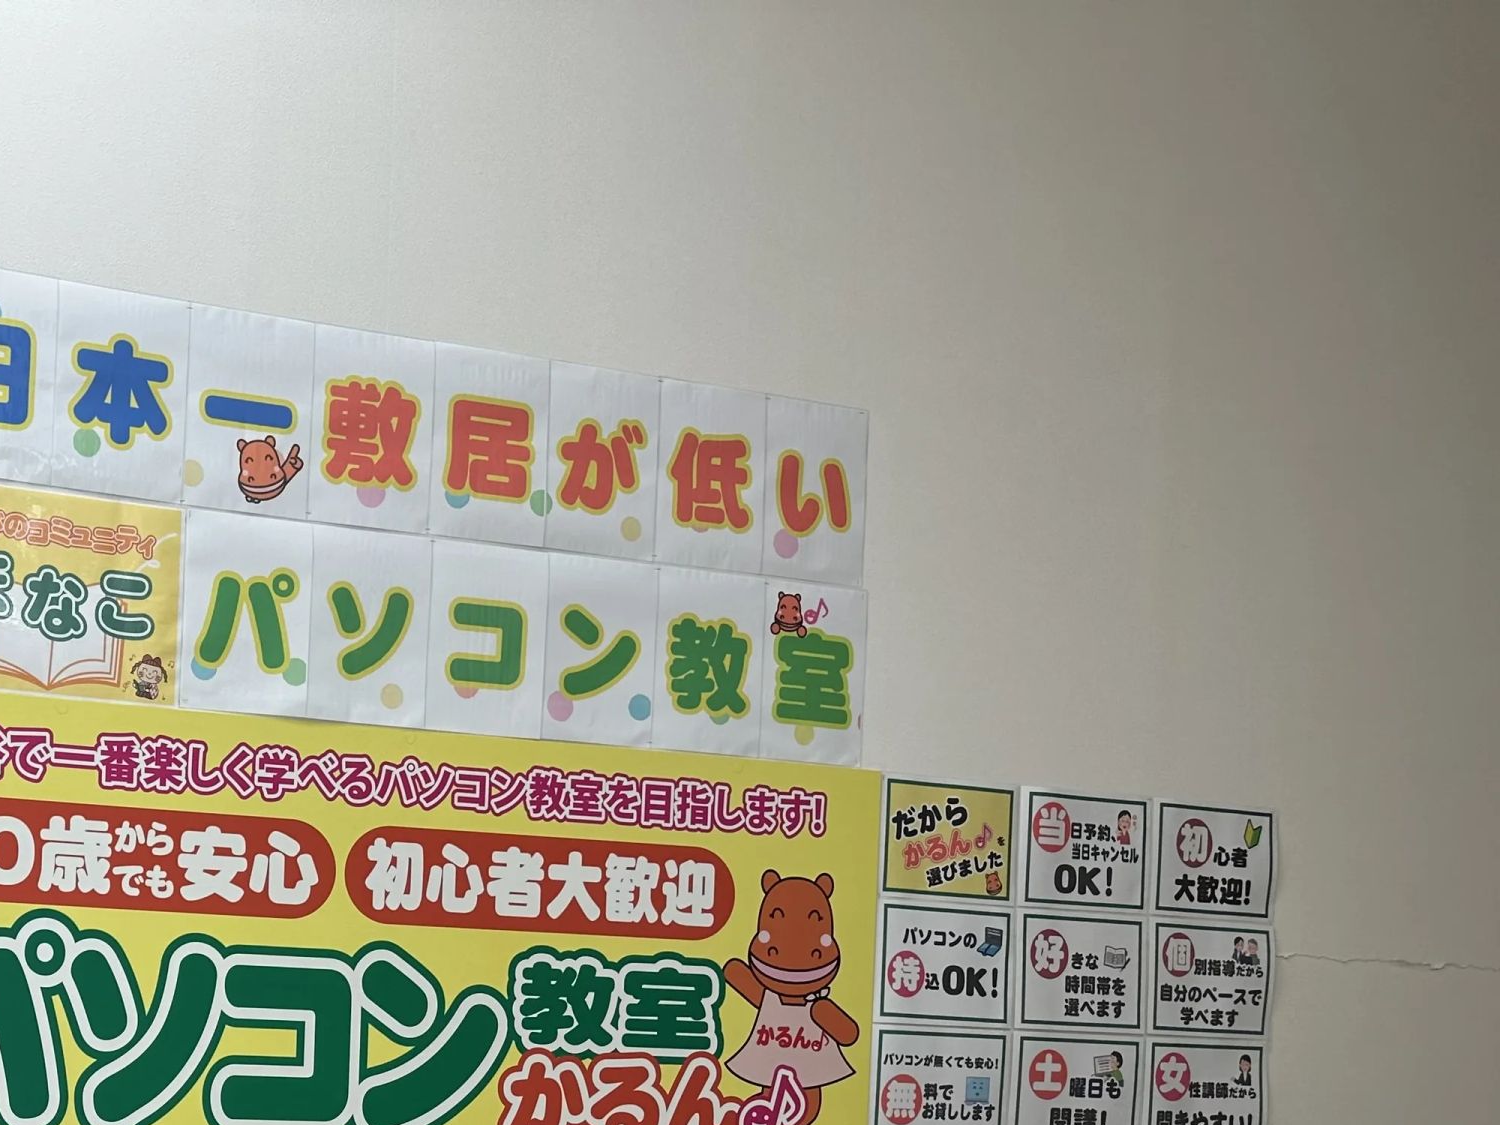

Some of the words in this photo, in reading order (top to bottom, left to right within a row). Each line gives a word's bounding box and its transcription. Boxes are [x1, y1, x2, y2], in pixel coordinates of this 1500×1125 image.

[195, 568, 852, 730] パソコン教室
[891, 797, 968, 840] だから
[1071, 845, 1139, 864] 当日キャンセル
[925, 851, 1004, 888] 選びました
[1054, 865, 1113, 896] OK!
[366, 837, 716, 928] 初心者大歓迎
[1174, 874, 1251, 906] 大歓迎!
[903, 926, 977, 948] パソコンの
[1064, 975, 1126, 996] 時間帯を
[1160, 984, 1262, 1006] 自分のペースで
[509, 946, 726, 1062] 教室
[1064, 998, 1125, 1018] 選べます
[1180, 1007, 1239, 1027] 学べます
[883, 1053, 999, 1070] パソコンが無くても安心!
[923, 1103, 995, 1122] お貸しします
